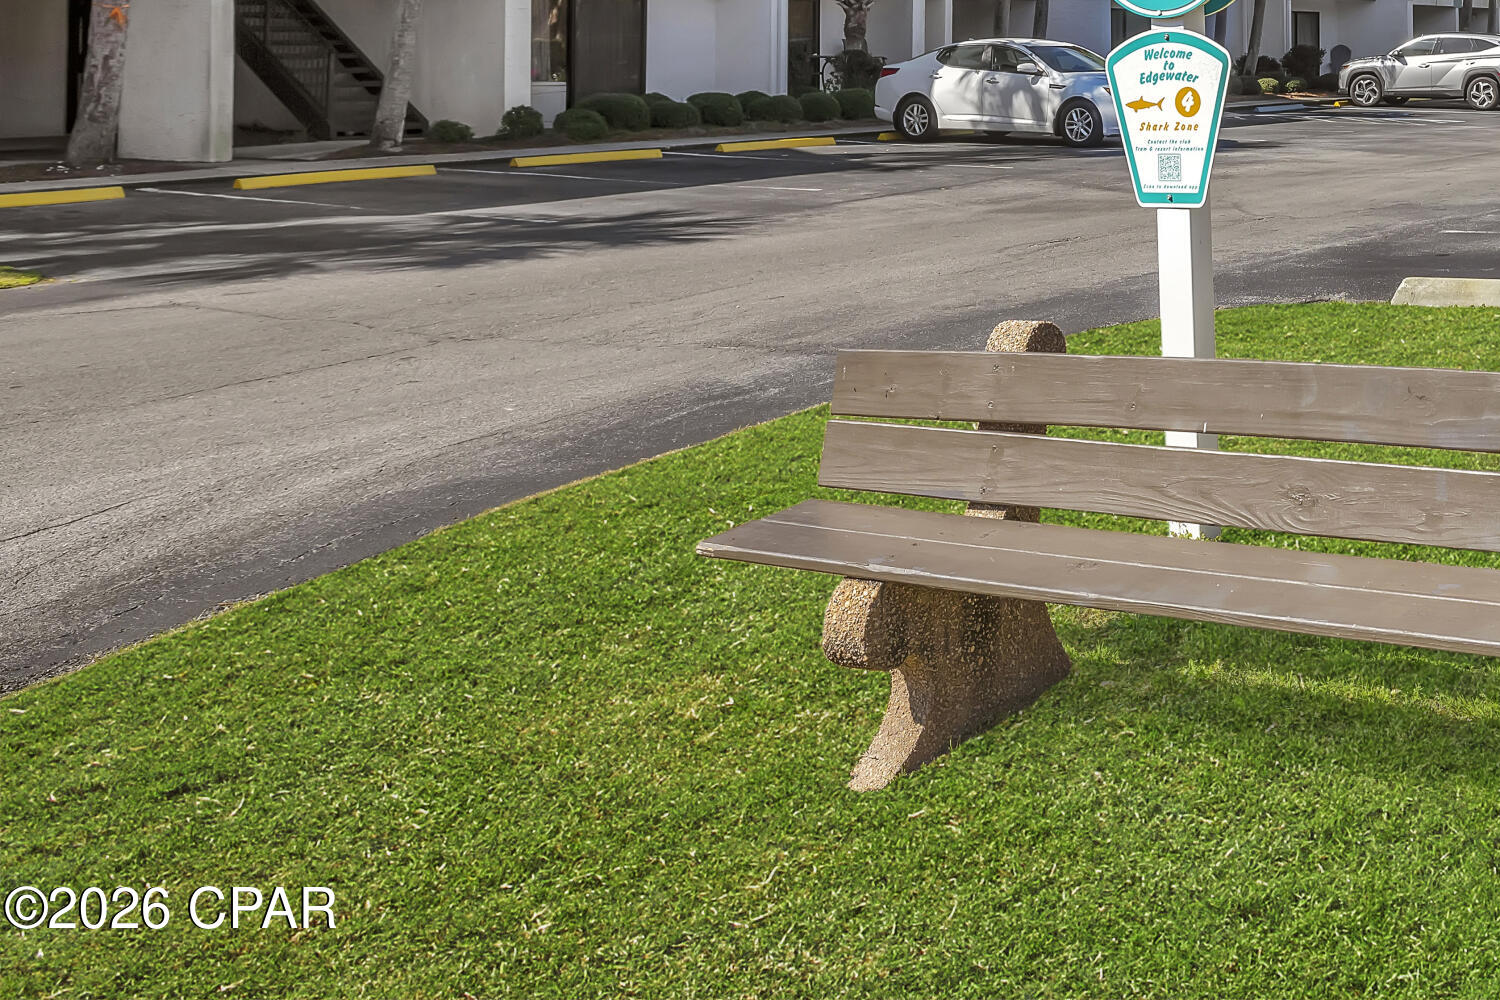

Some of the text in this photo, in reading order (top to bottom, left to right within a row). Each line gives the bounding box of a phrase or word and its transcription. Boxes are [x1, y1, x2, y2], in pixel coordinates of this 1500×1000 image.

[1144, 47, 1193, 61] Welcome
[1163, 60, 1175, 71] to
[1139, 71, 1199, 86] Edgewater
[1181, 90, 1195, 113] 4
[1139, 121, 1199, 132] Shark Zone
